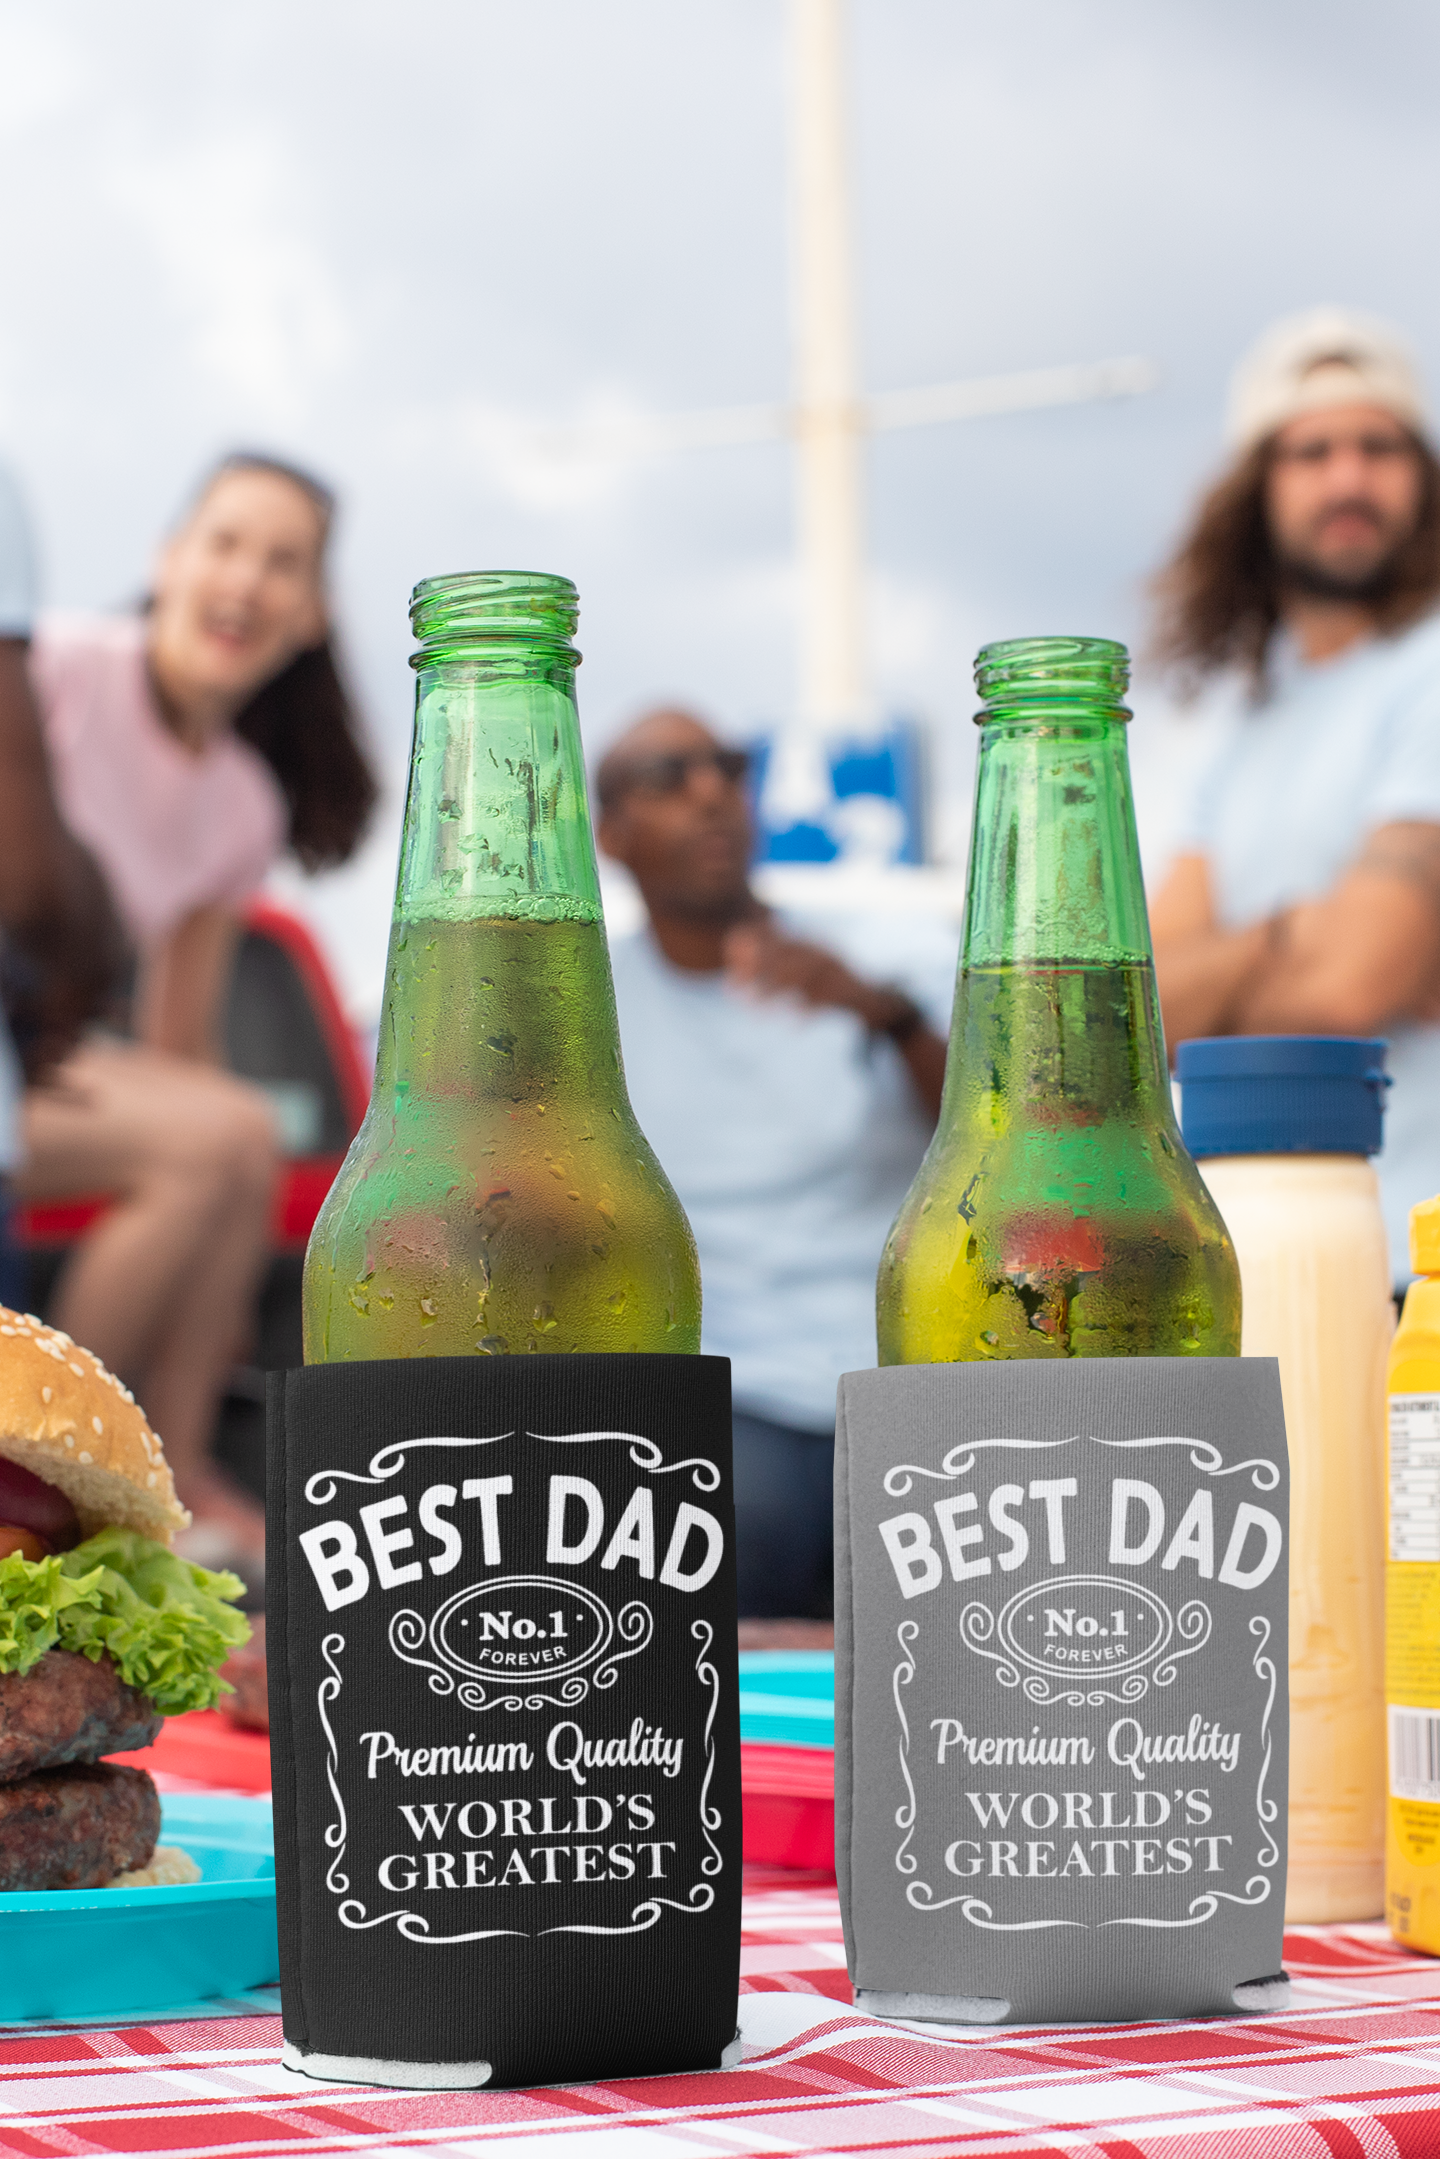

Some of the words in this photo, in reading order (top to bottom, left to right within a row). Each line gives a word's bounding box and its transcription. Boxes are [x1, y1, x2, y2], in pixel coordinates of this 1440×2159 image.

[299, 1475, 513, 1612] BEST
[546, 1475, 723, 1592] DAD
[879, 1477, 1077, 1599] BEST
[1109, 1478, 1282, 1589] DAD
[479, 1611, 568, 1640] No.1
[1044, 1609, 1128, 1637] No.1
[479, 1646, 566, 1665] FOREVER
[1044, 1644, 1128, 1662] FOREVER
[360, 1732, 534, 1778] Premium
[546, 1717, 683, 1785] Quality
[930, 1719, 1095, 1765] Premium
[1108, 1714, 1240, 1780] Quality
[398, 1794, 655, 1840] WORLD'S
[965, 1789, 1212, 1828] WORLD'S
[378, 1842, 675, 1891] GREATEST
[945, 1836, 1232, 1877] GREATEST
